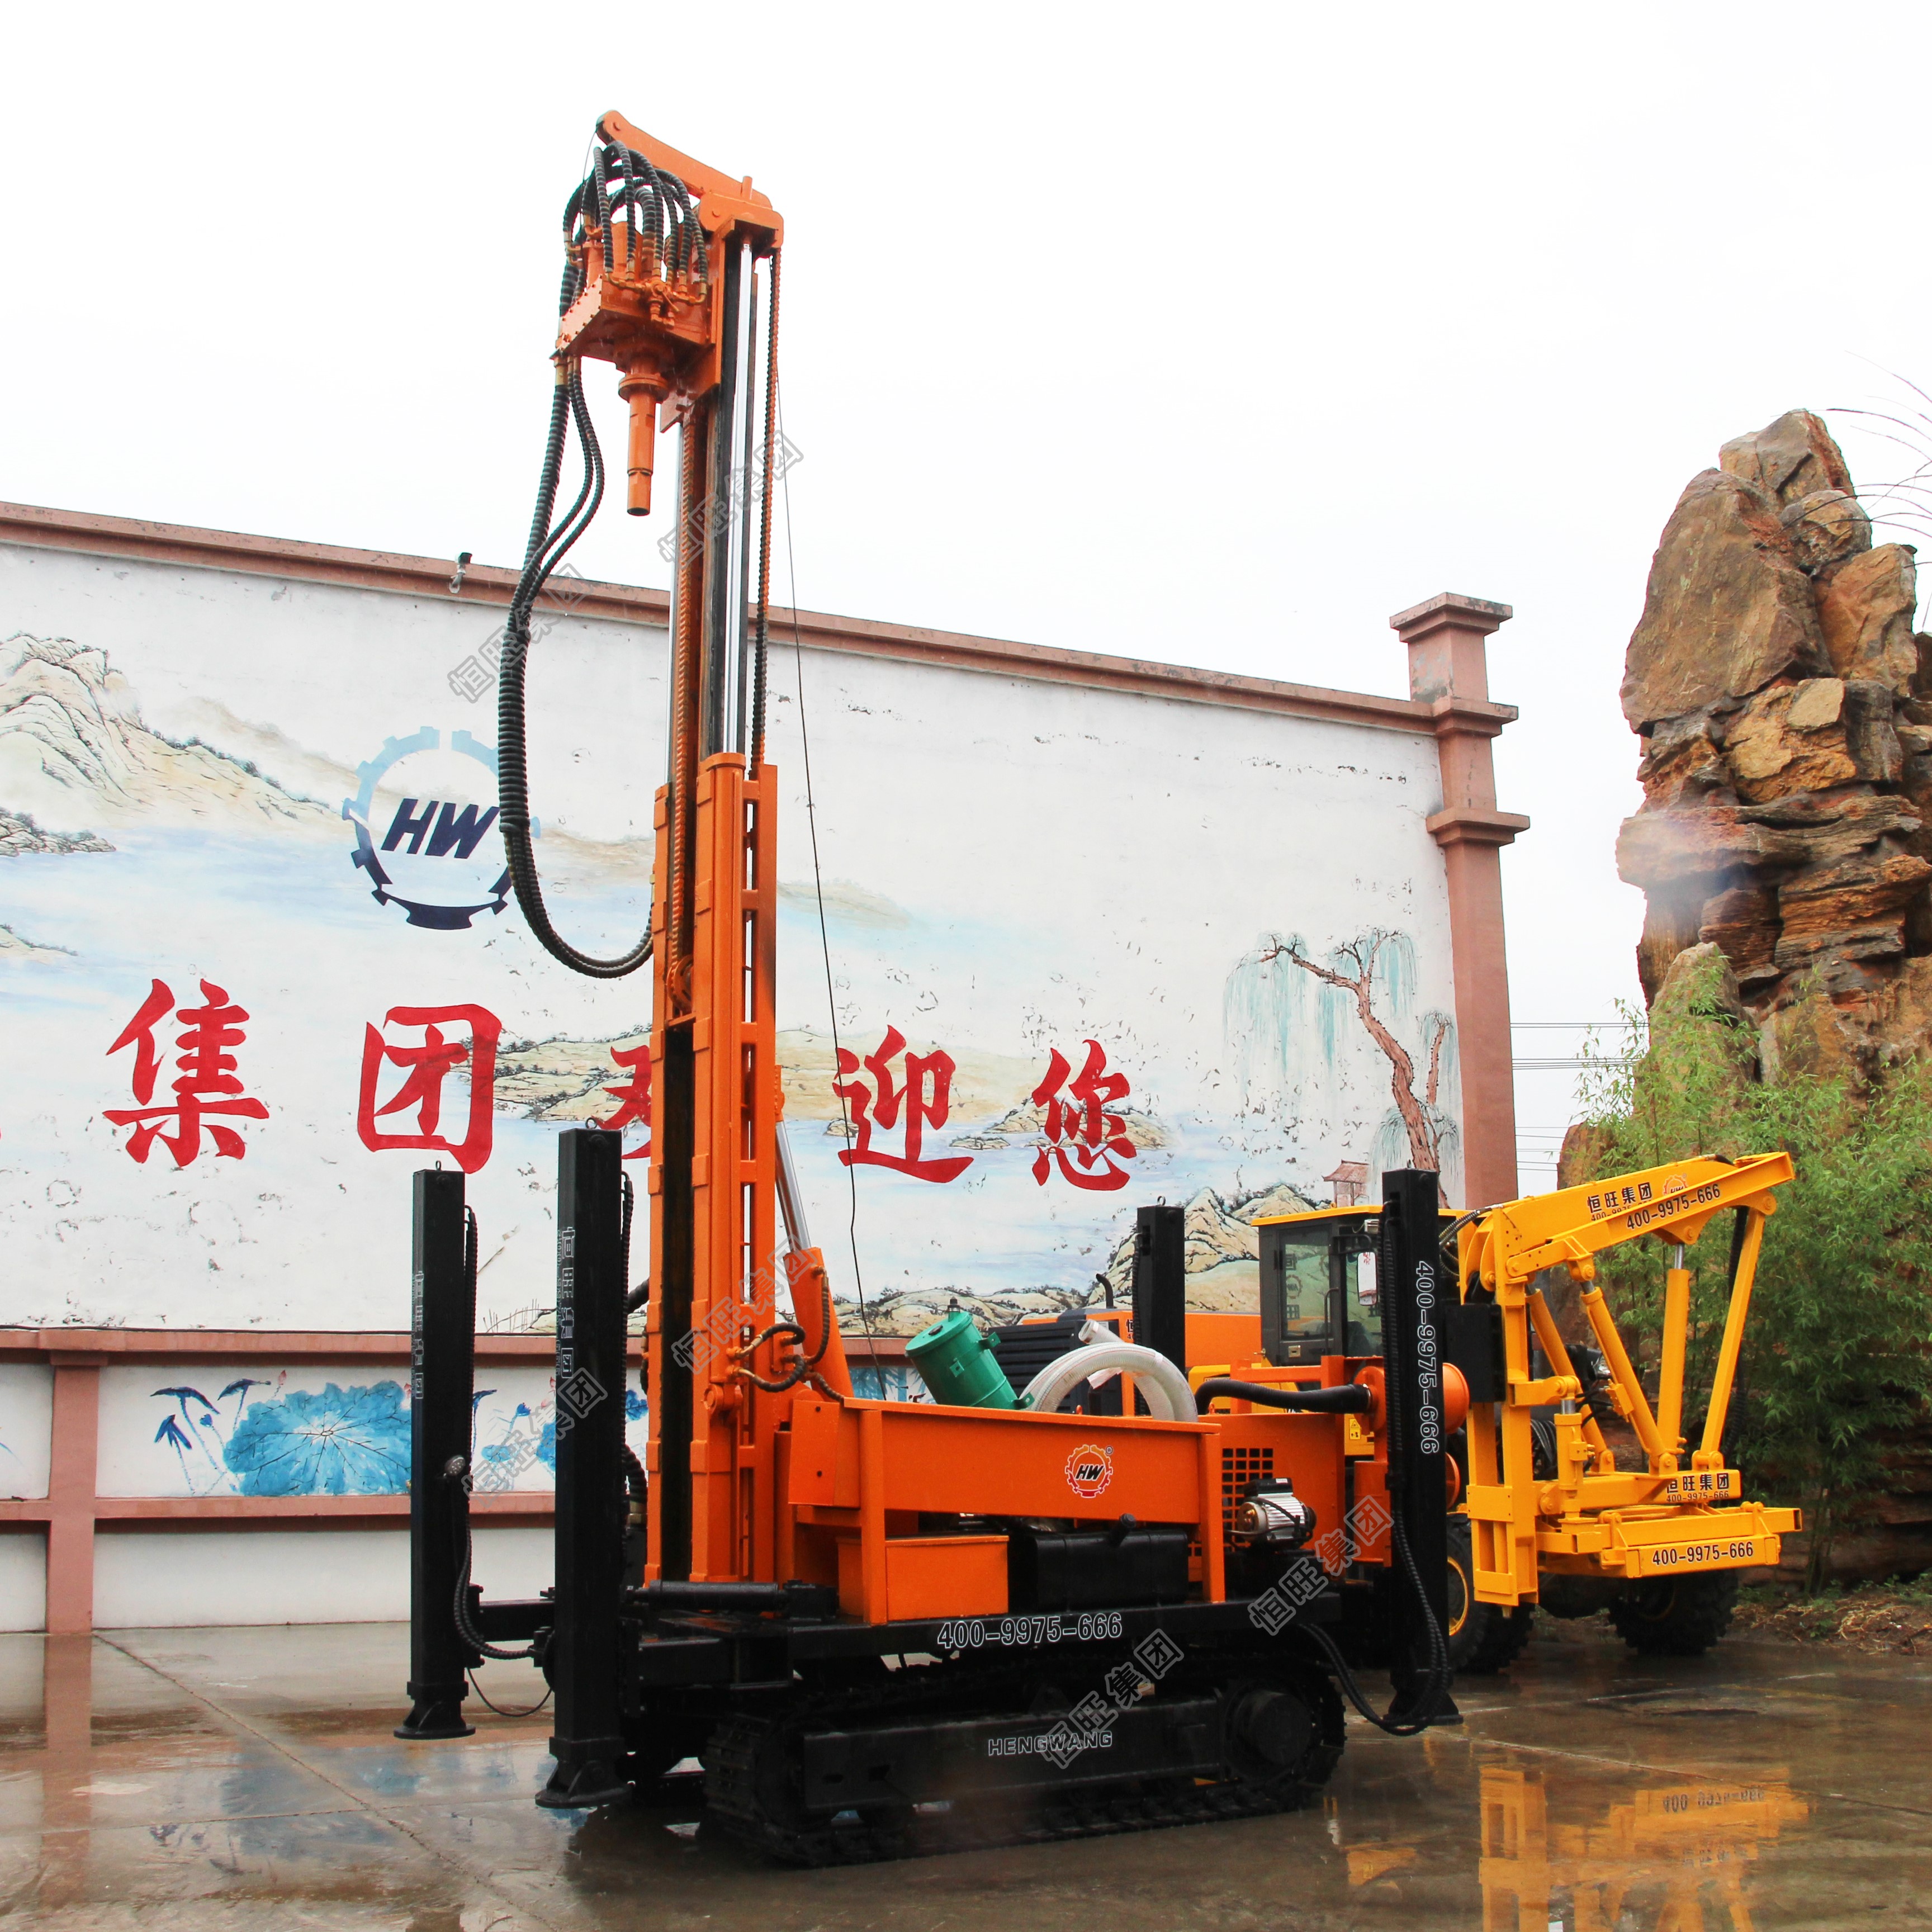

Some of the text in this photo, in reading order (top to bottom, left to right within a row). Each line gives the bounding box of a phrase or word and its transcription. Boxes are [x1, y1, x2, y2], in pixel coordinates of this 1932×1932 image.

[381, 798, 500, 859] HW
[1587, 1182, 1652, 1213] 恒旺集团
[1627, 1183, 1721, 1230] 400-9975-666
[561, 1227, 575, 1378] 恒旺集团
[1416, 1261, 1439, 1454] 400-9975-666
[1075, 1464, 1105, 1481] HW
[1666, 1491, 1729, 1503] 400-9975-666
[1652, 1541, 1754, 1566] 400-9975-666
[937, 1612, 1123, 1650] 400-9975-666
[988, 1730, 1112, 1756] HENGWANG
